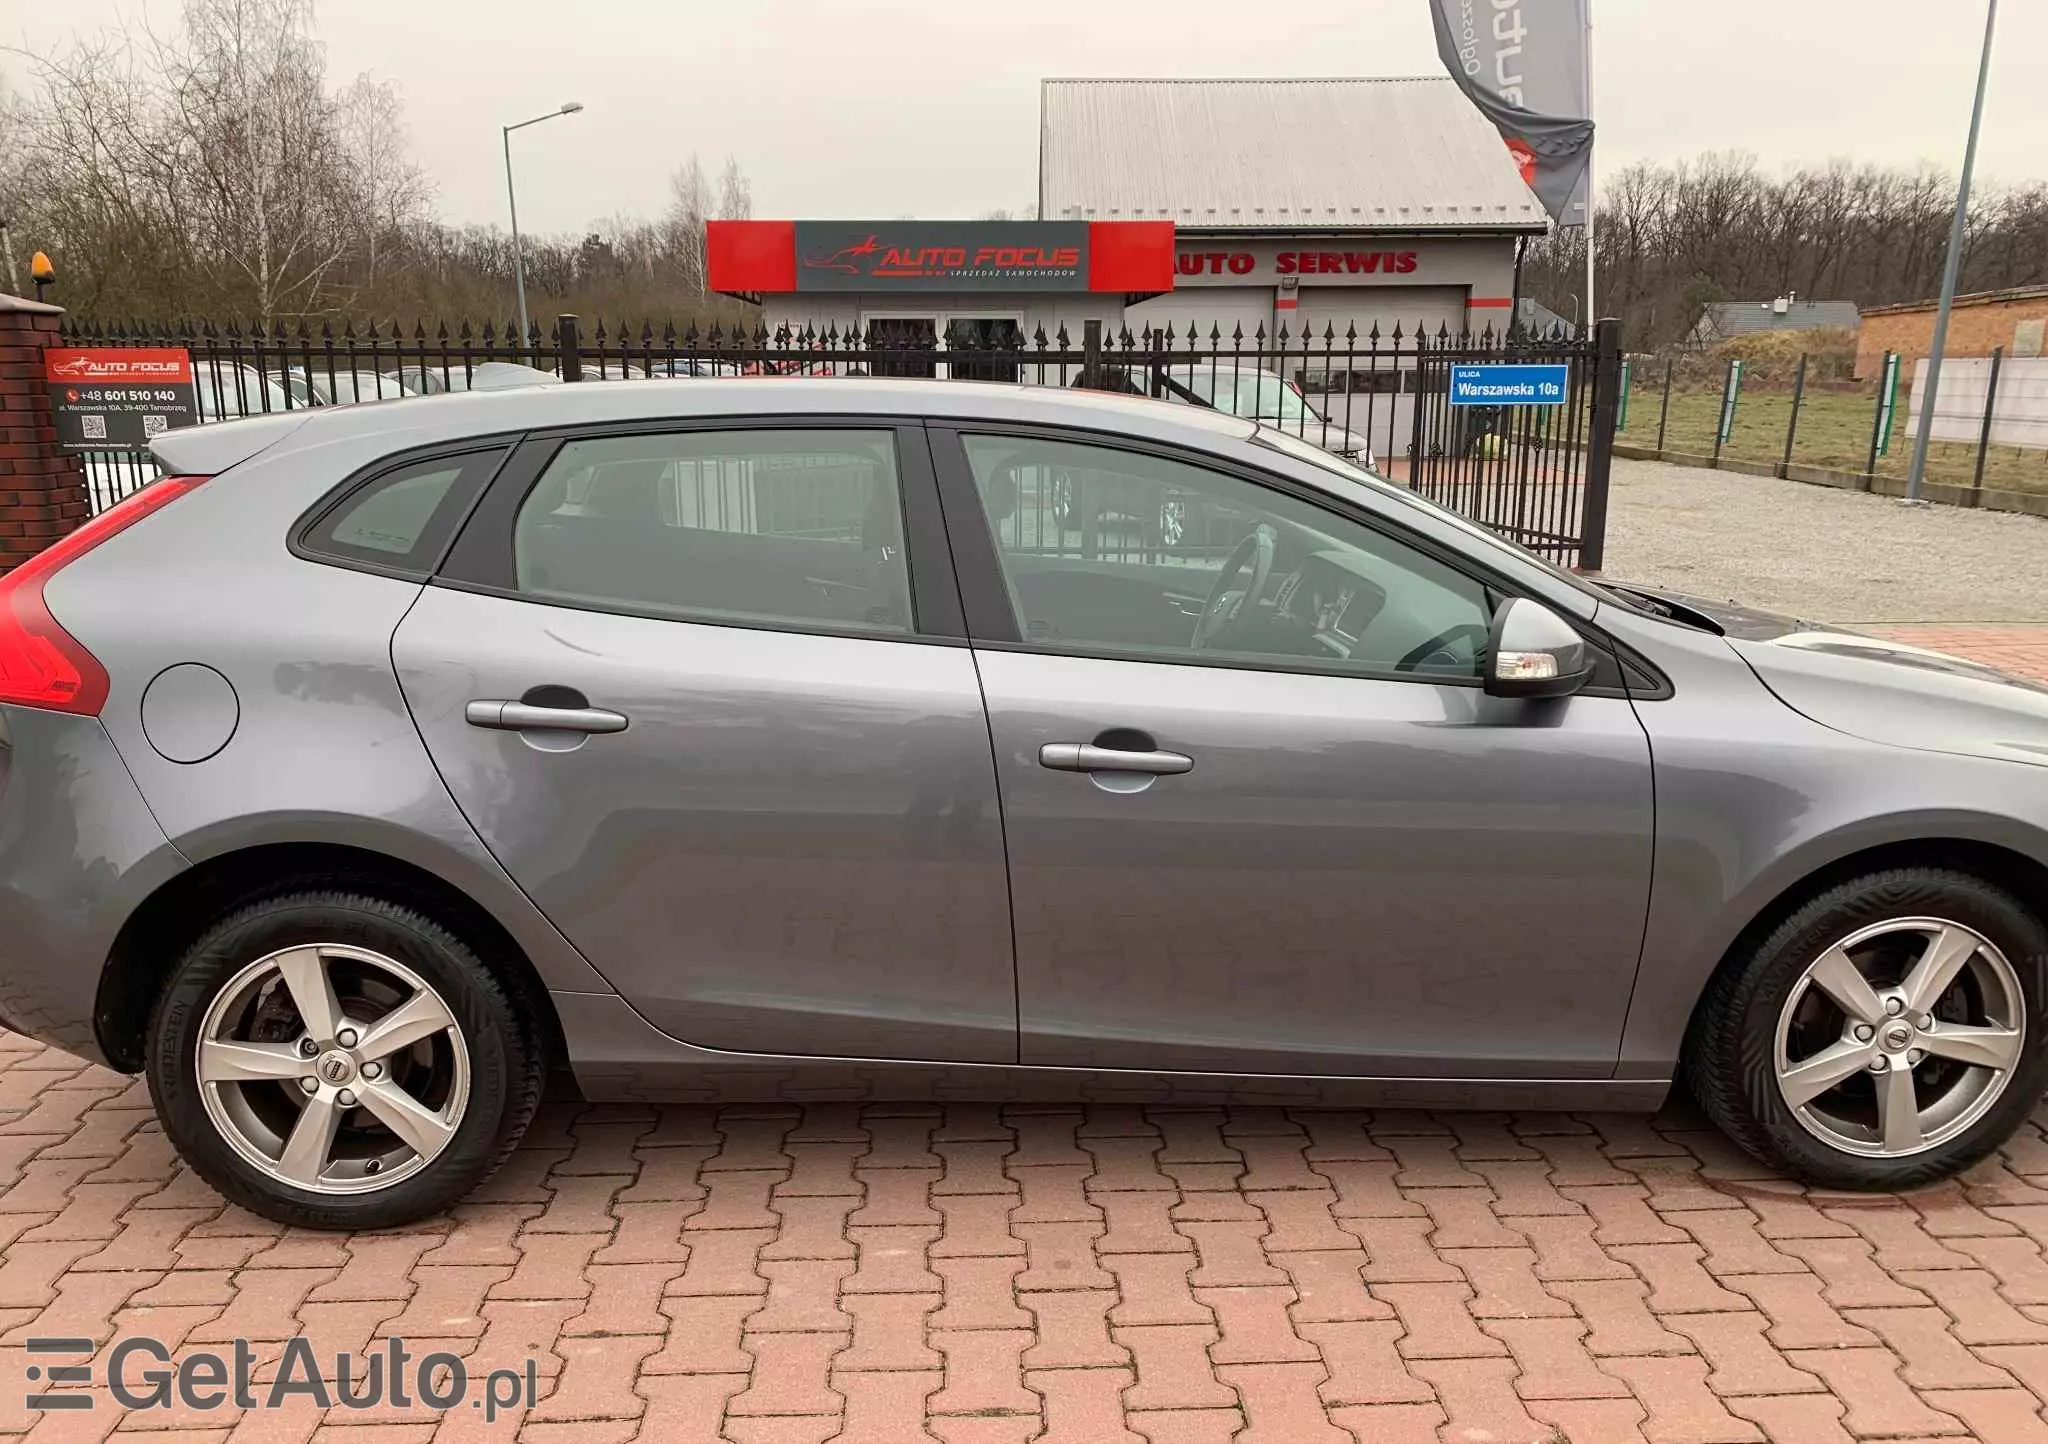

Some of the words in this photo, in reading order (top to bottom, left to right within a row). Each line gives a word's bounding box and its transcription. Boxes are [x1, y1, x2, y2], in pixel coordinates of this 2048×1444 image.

[880, 247, 966, 266] AUTO
[973, 247, 1080, 266] FOCUS
[1174, 252, 1255, 275] UTO
[1276, 252, 1417, 274] SERWIS
[87, 362, 127, 372] AUTO
[131, 362, 180, 372] FOCUS
[80, 391, 101, 401] +48
[104, 391, 126, 401] 601
[129, 391, 151, 401] 510
[154, 391, 176, 401] 140
[1458, 382, 1535, 396] Warszawska
[1538, 382, 1560, 395] 10a
